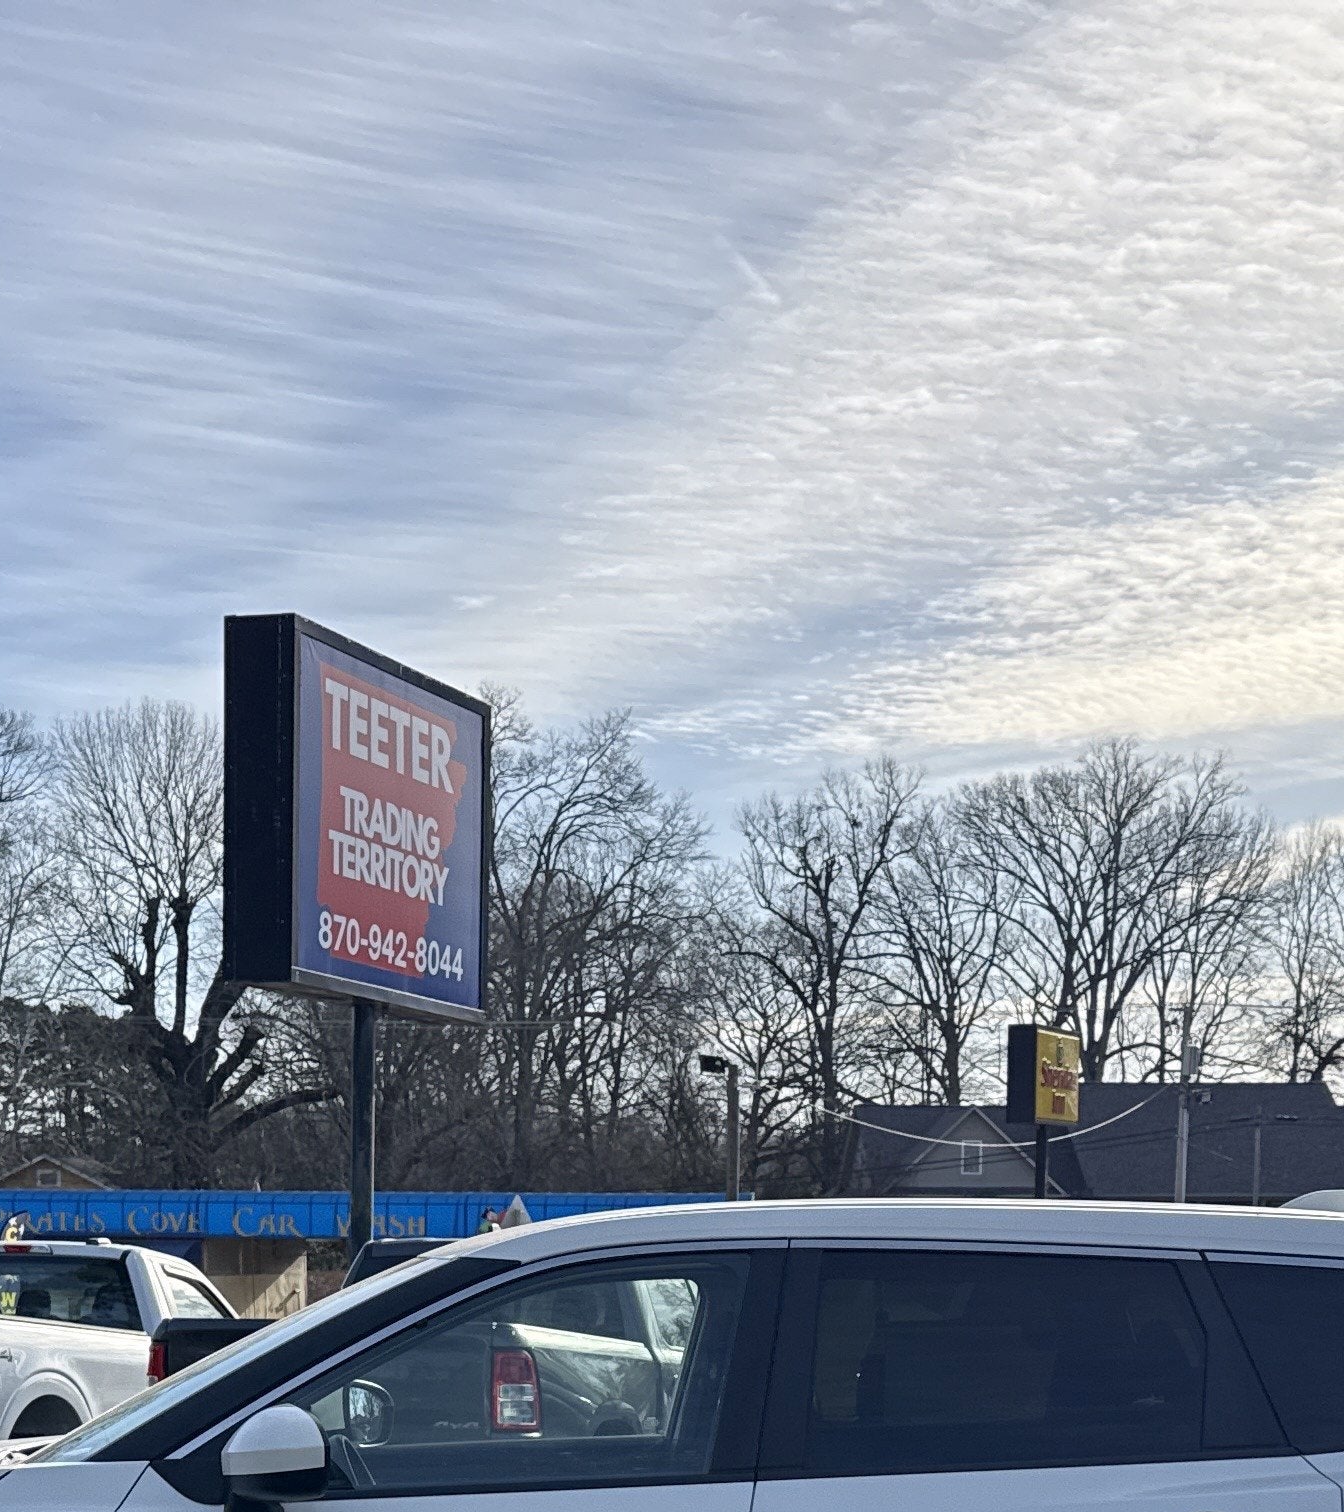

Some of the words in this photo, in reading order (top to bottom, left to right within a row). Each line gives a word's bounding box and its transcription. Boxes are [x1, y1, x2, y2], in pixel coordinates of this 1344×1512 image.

[325, 678, 454, 794] TEETER
[340, 785, 441, 860] TRADING
[328, 829, 450, 906] TERRITORY
[318, 910, 464, 981] 870-942-8044
